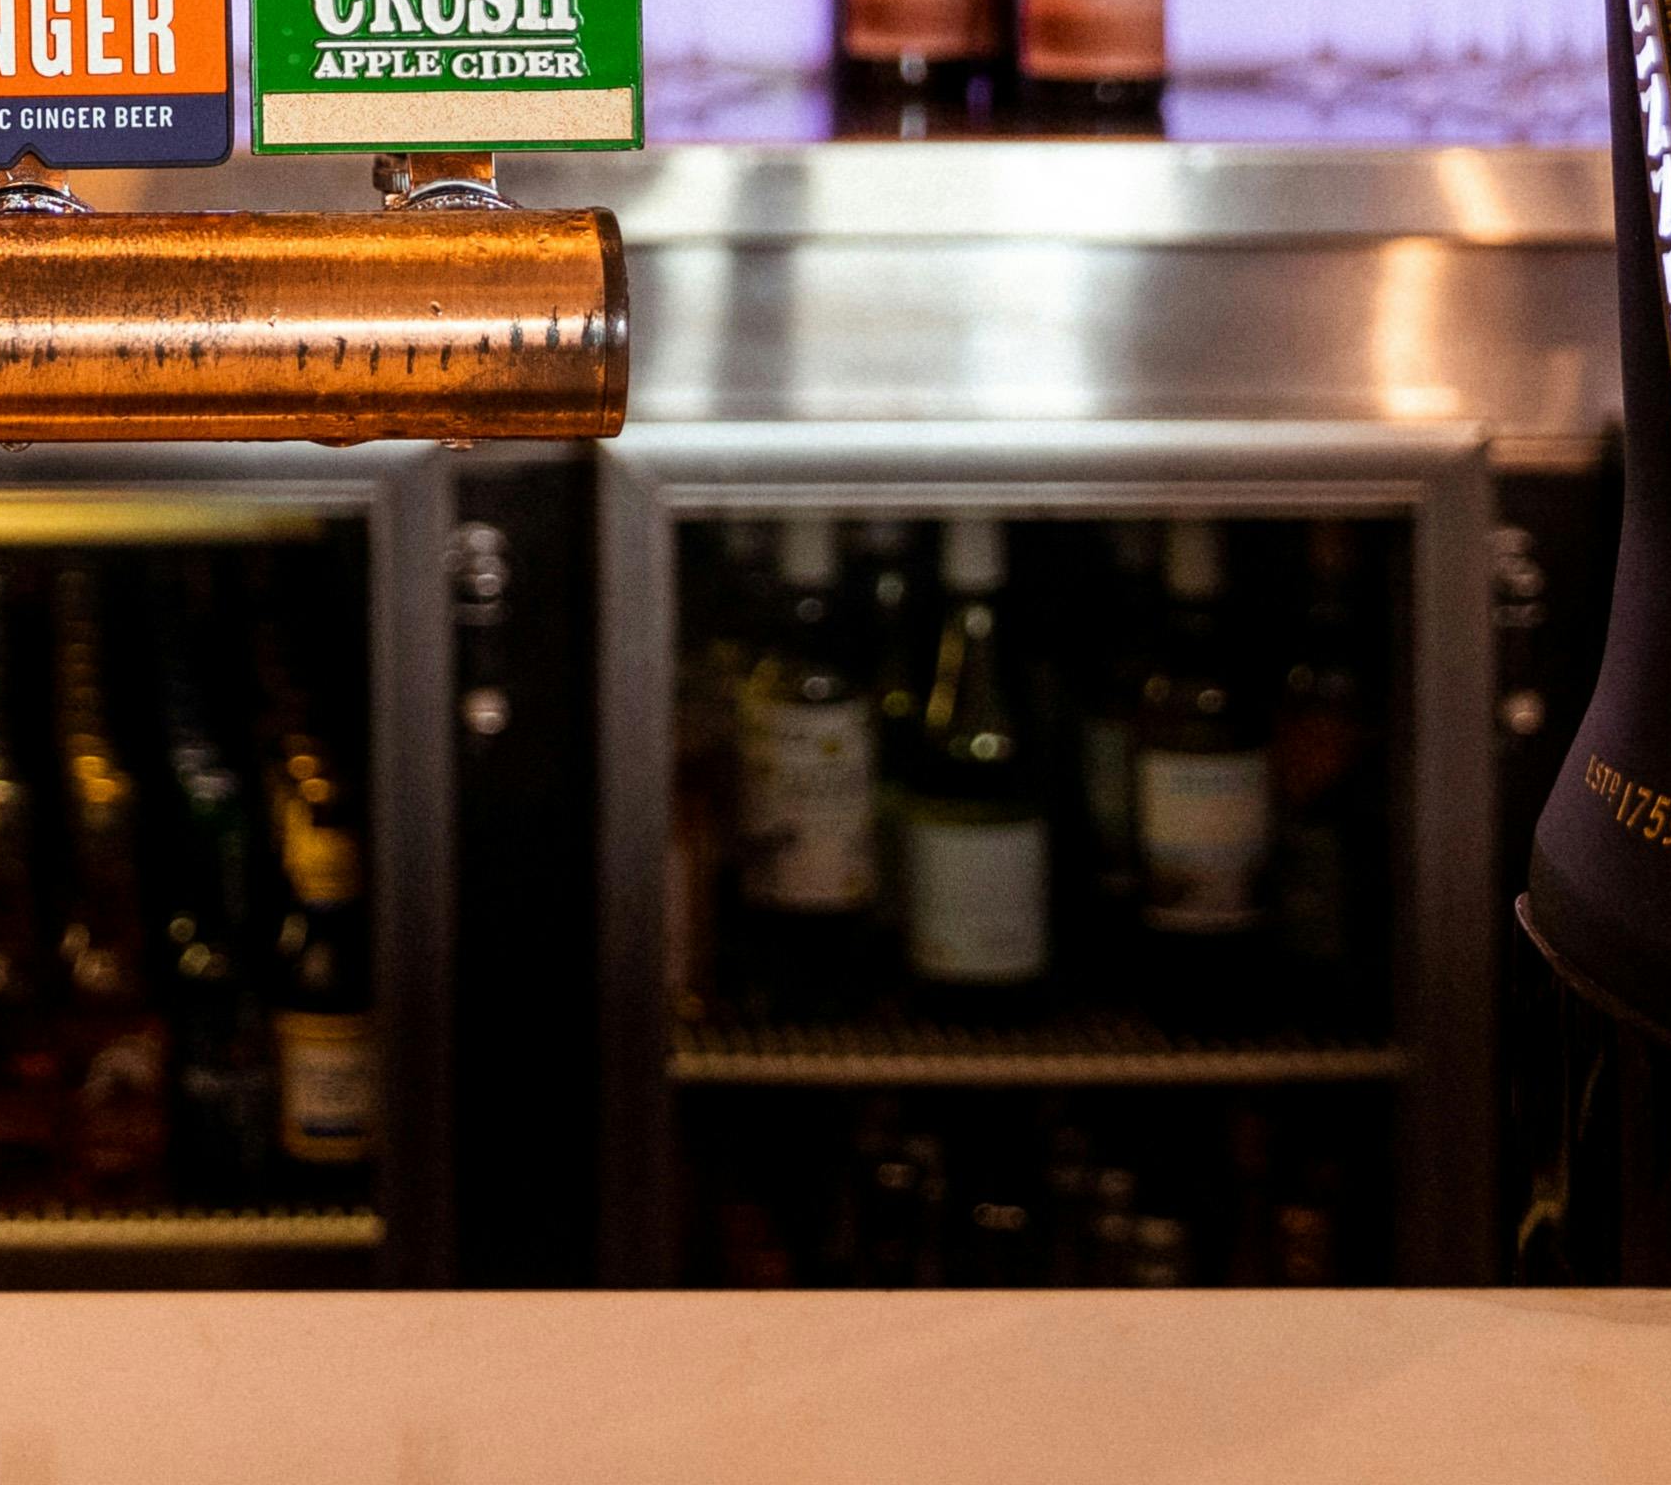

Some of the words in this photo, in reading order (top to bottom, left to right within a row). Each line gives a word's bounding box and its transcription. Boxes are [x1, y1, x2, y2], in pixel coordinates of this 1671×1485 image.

[314, 51, 439, 79] APPLE
[451, 50, 583, 79] CIDER
[20, 107, 105, 129] GINGER
[115, 106, 173, 128] BEER
